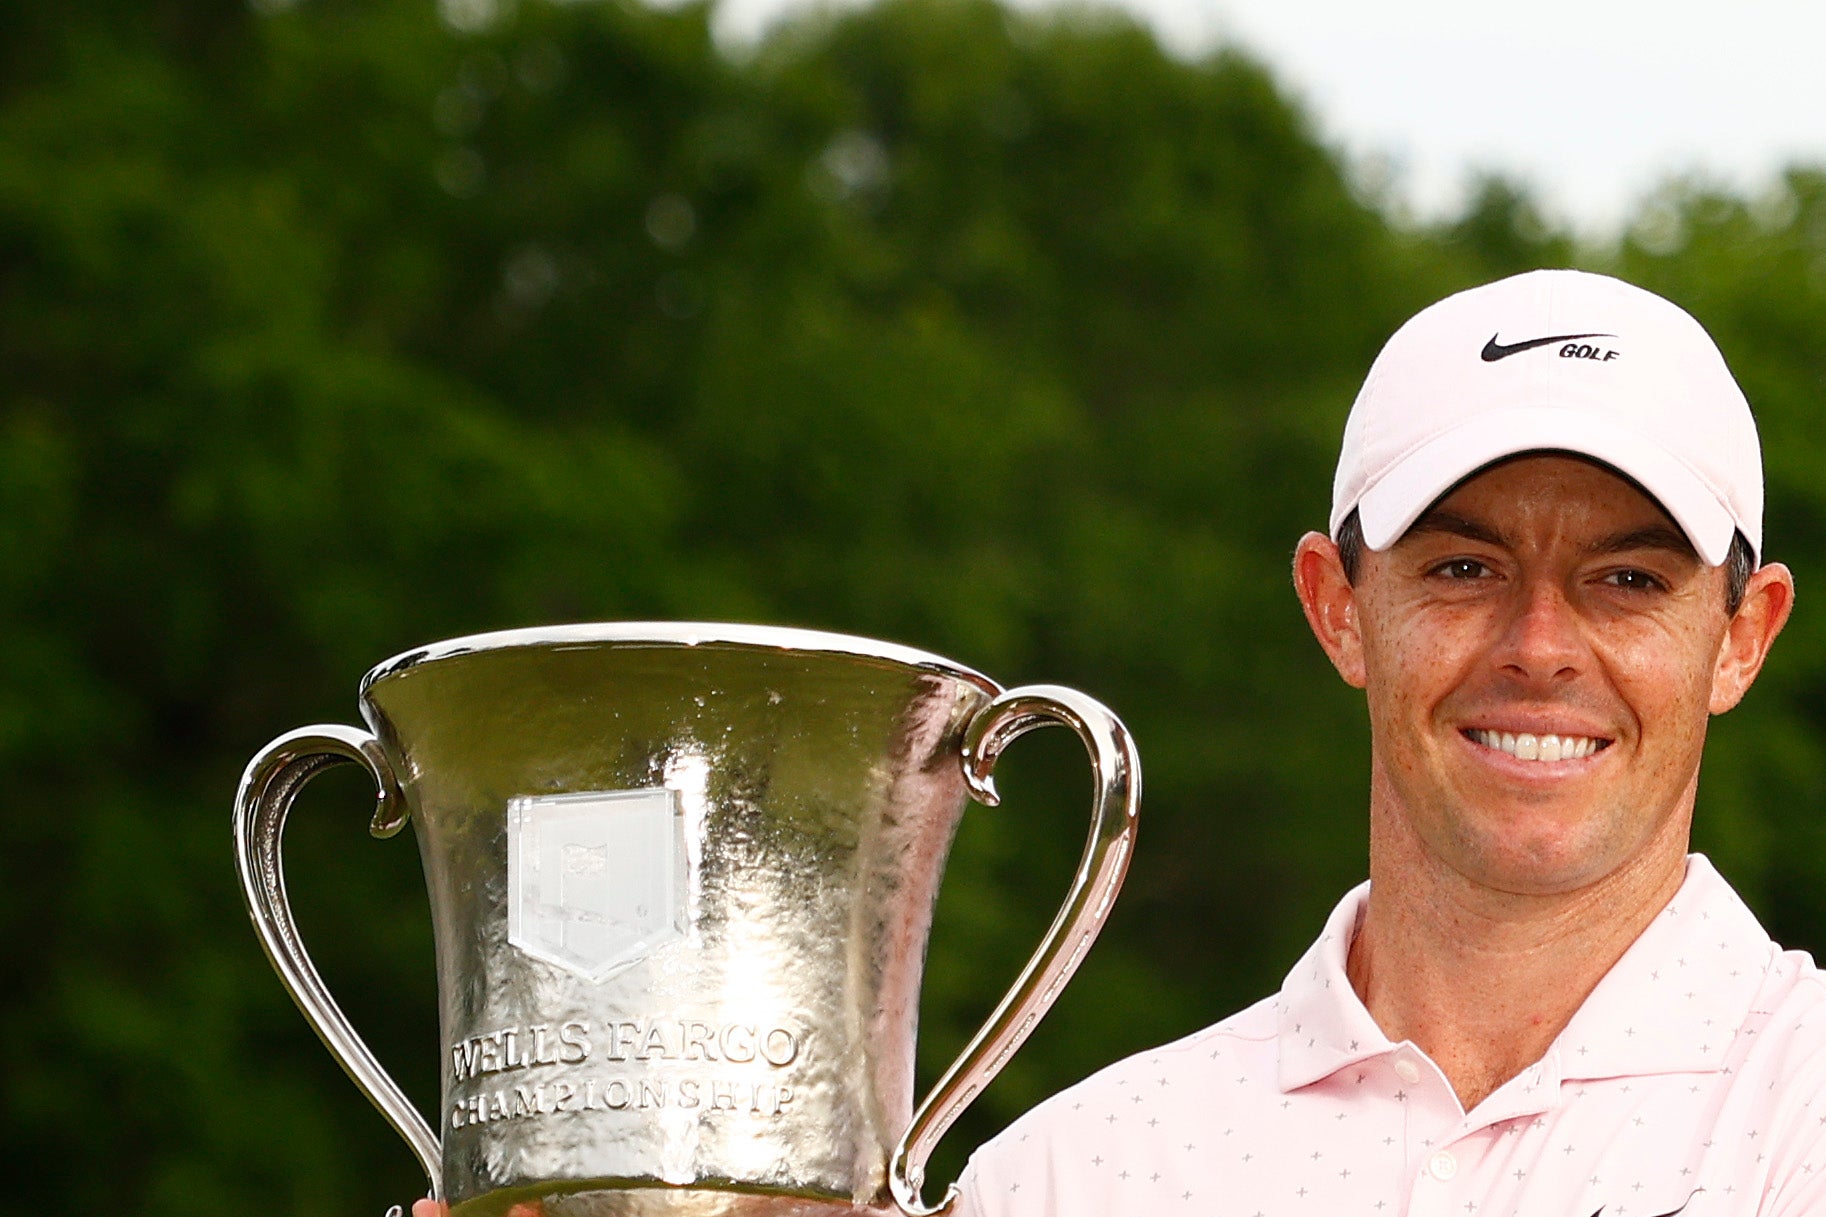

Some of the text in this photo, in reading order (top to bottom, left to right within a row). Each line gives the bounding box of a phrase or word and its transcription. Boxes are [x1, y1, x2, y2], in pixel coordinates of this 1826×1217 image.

[1559, 344, 1620, 361] GOLF
[452, 1021, 799, 1081] WELLS FARGO
[451, 1079, 795, 1130] CHAMPIONSHIP
